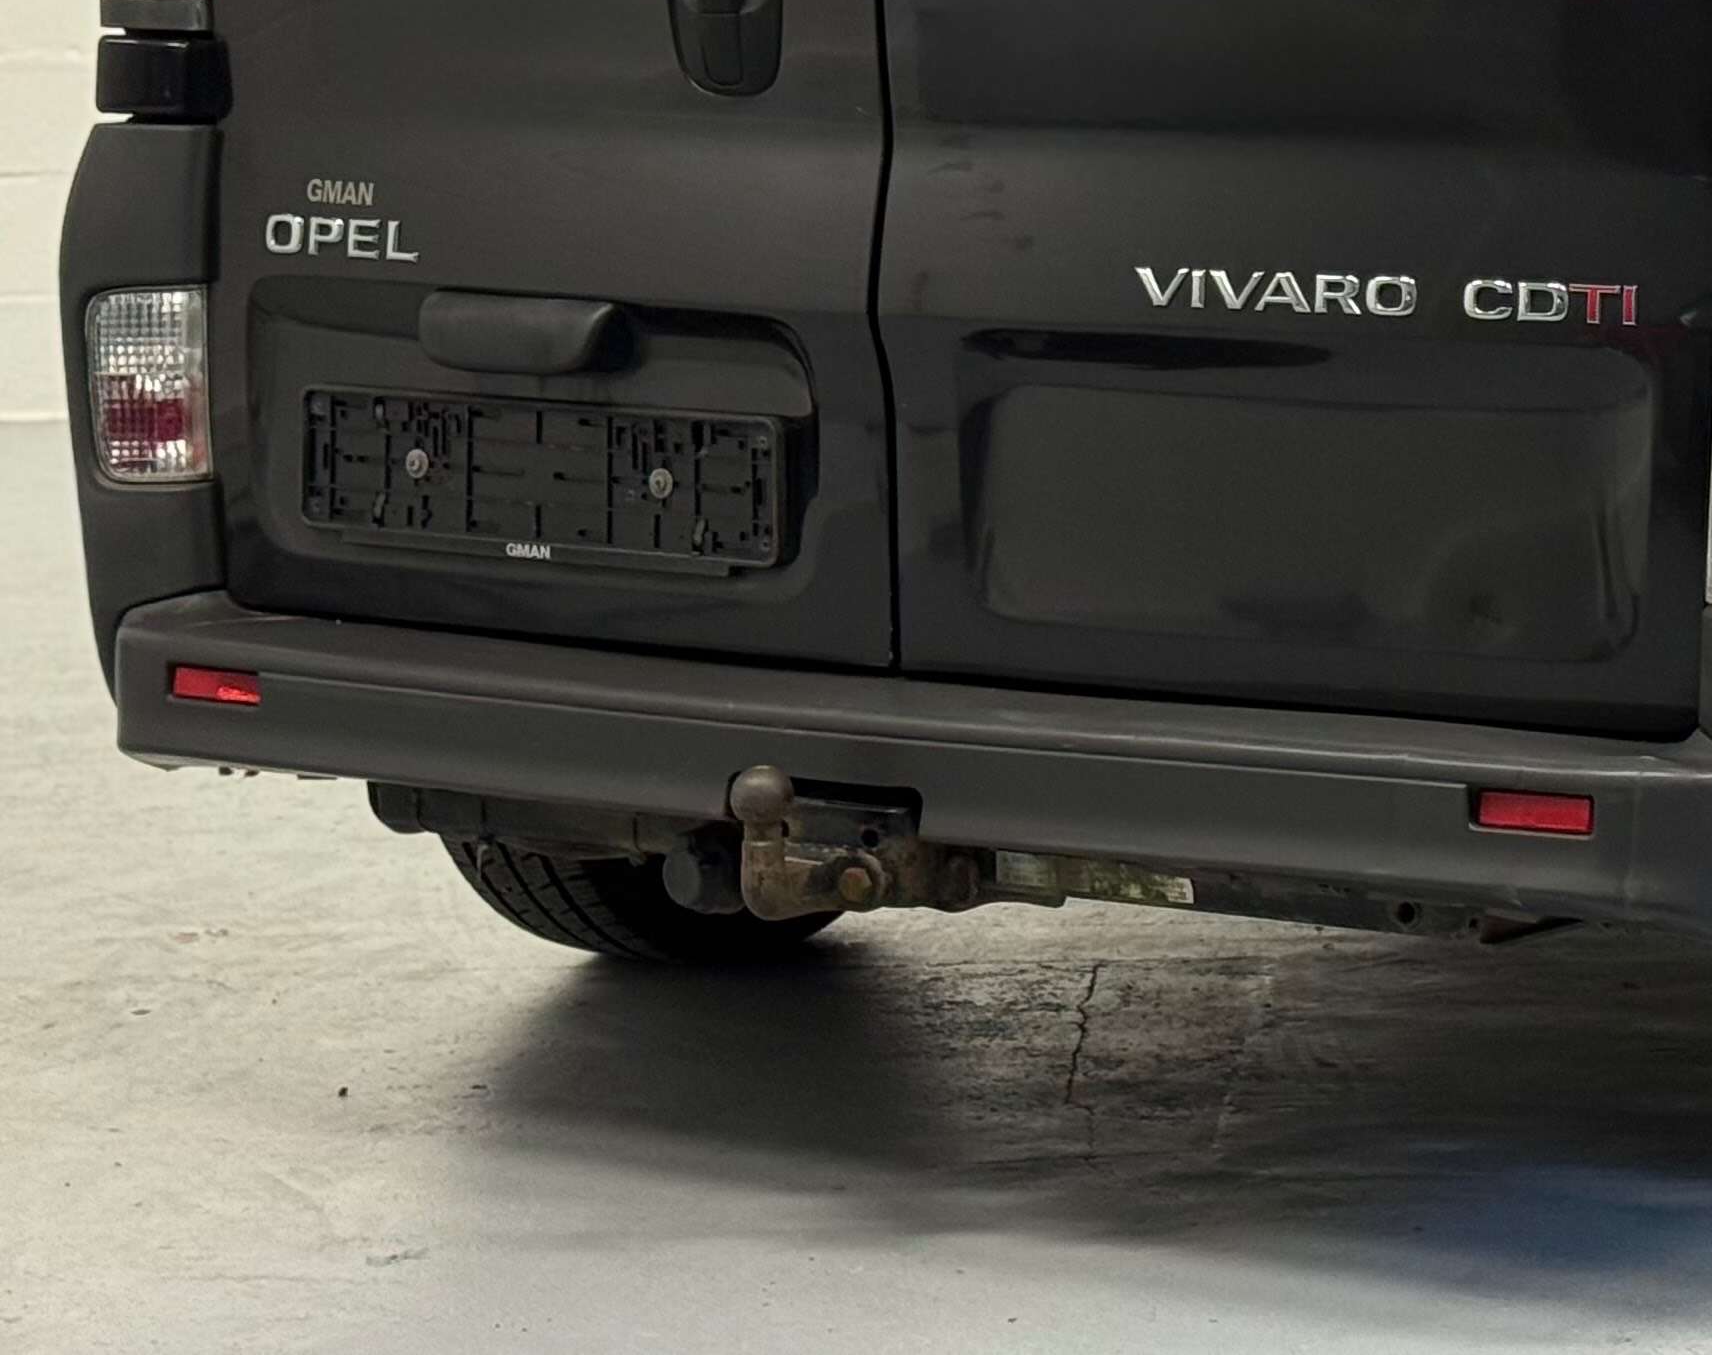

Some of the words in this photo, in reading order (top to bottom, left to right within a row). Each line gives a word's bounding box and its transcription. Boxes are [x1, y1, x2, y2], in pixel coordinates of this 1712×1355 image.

[306, 178, 374, 206] GMAN
[265, 213, 420, 263] OPEL
[1135, 266, 1418, 317] VIVARO
[1463, 278, 1639, 327] CDTI
[505, 542, 551, 560] GMAN
